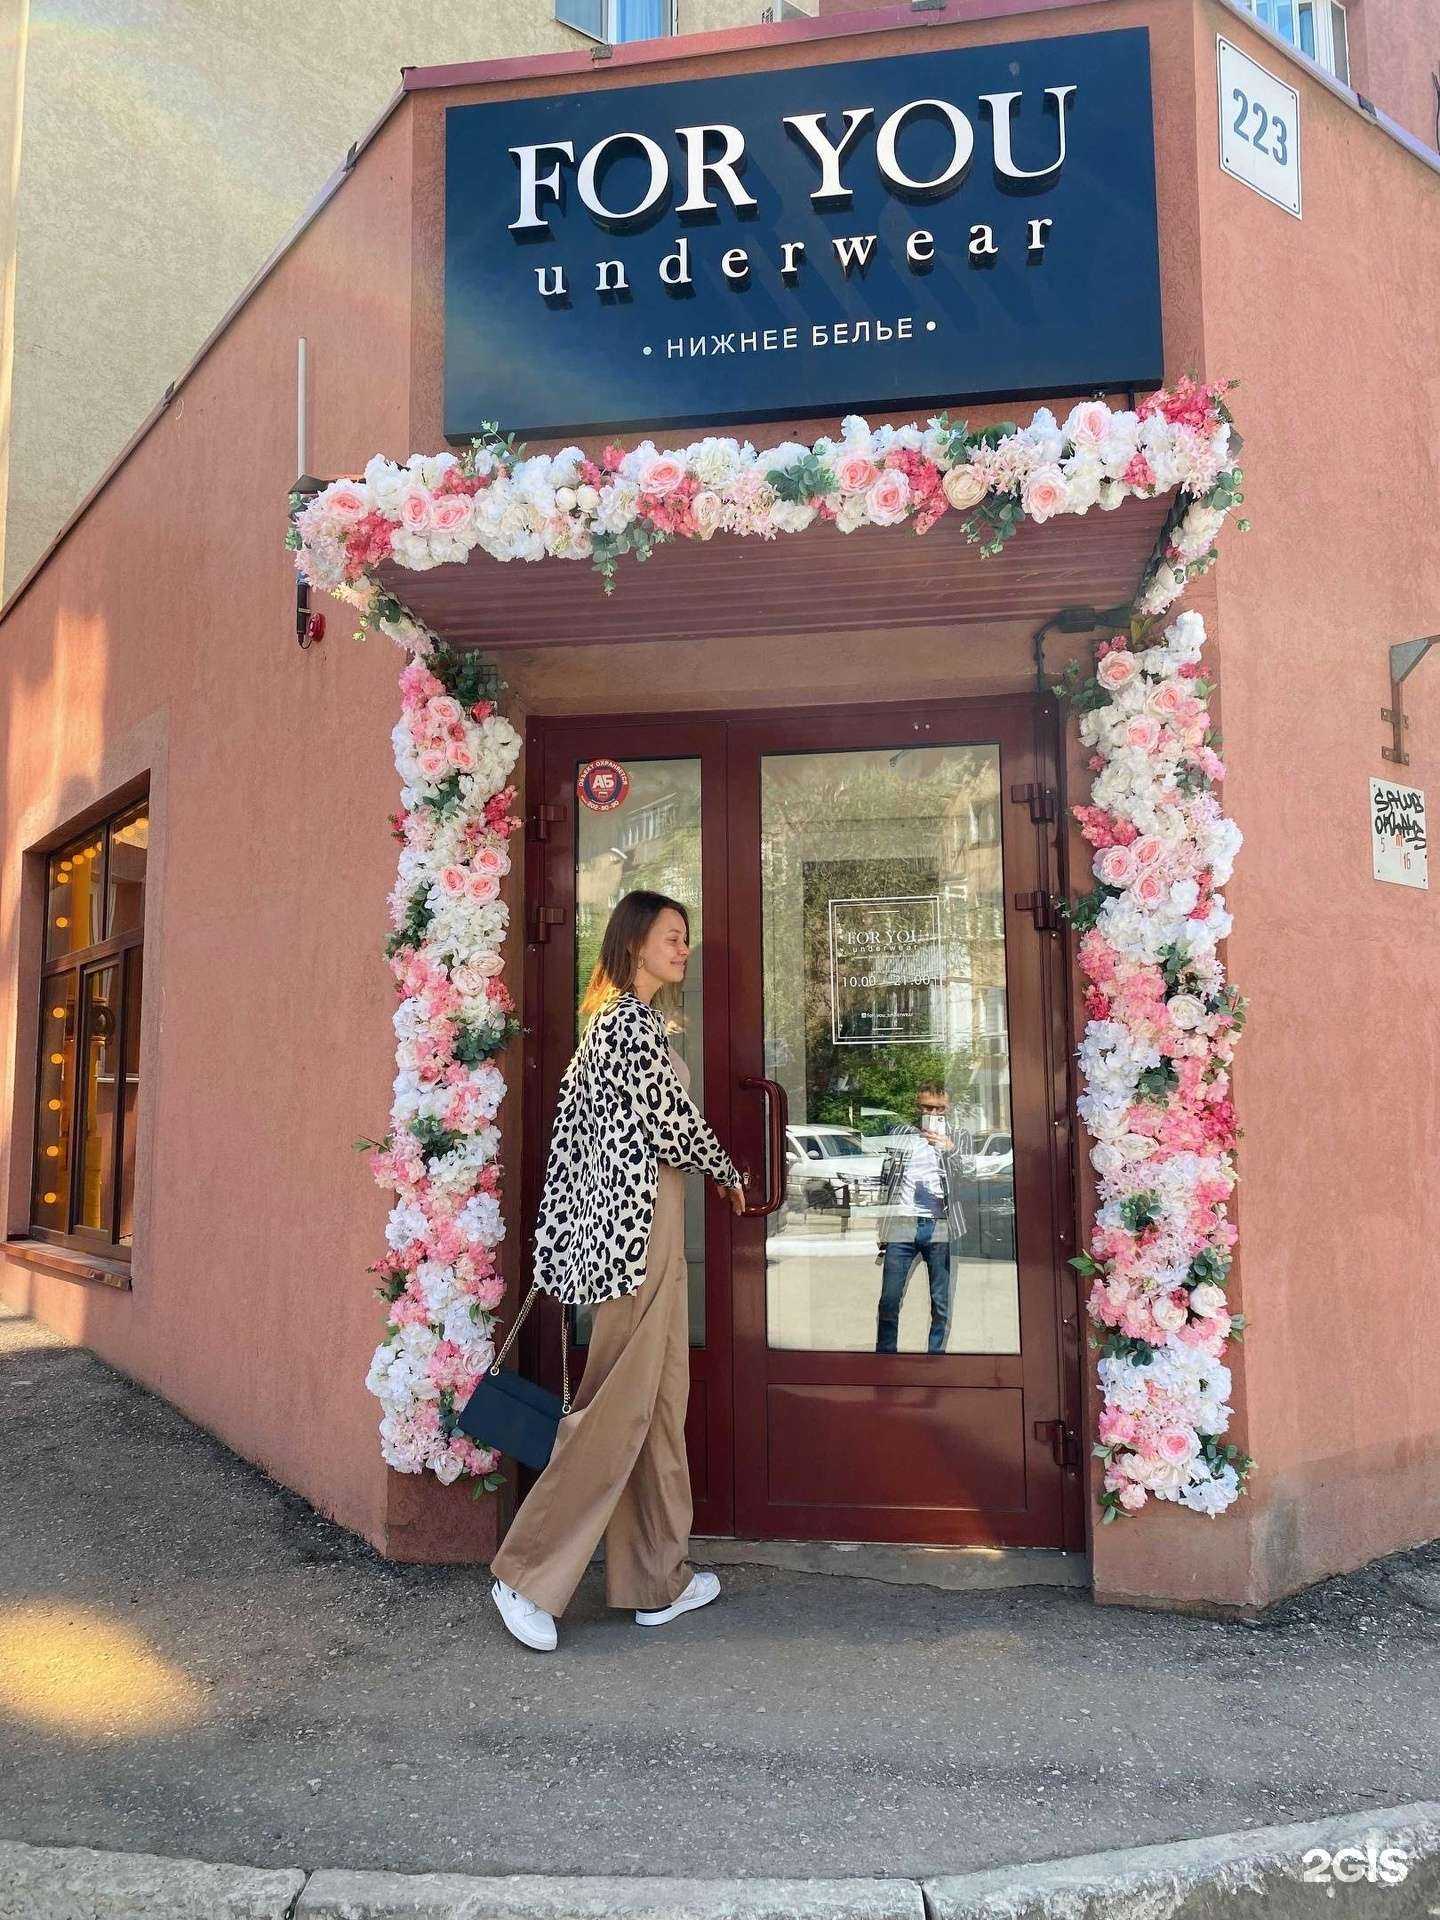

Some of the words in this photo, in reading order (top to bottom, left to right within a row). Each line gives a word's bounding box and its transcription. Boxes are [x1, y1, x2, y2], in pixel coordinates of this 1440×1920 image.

[1232, 88, 1288, 166] 223
[507, 124, 758, 229] FOR
[782, 85, 1077, 198] YOU
[534, 218, 1053, 296] underwear
[667, 325, 798, 359] НИЖНЕЕ
[812, 317, 914, 346] БЕЛЬЕ
[847, 931, 881, 945] FOR
[853, 943, 918, 953] underwear
[843, 976, 876, 988] 10.00
